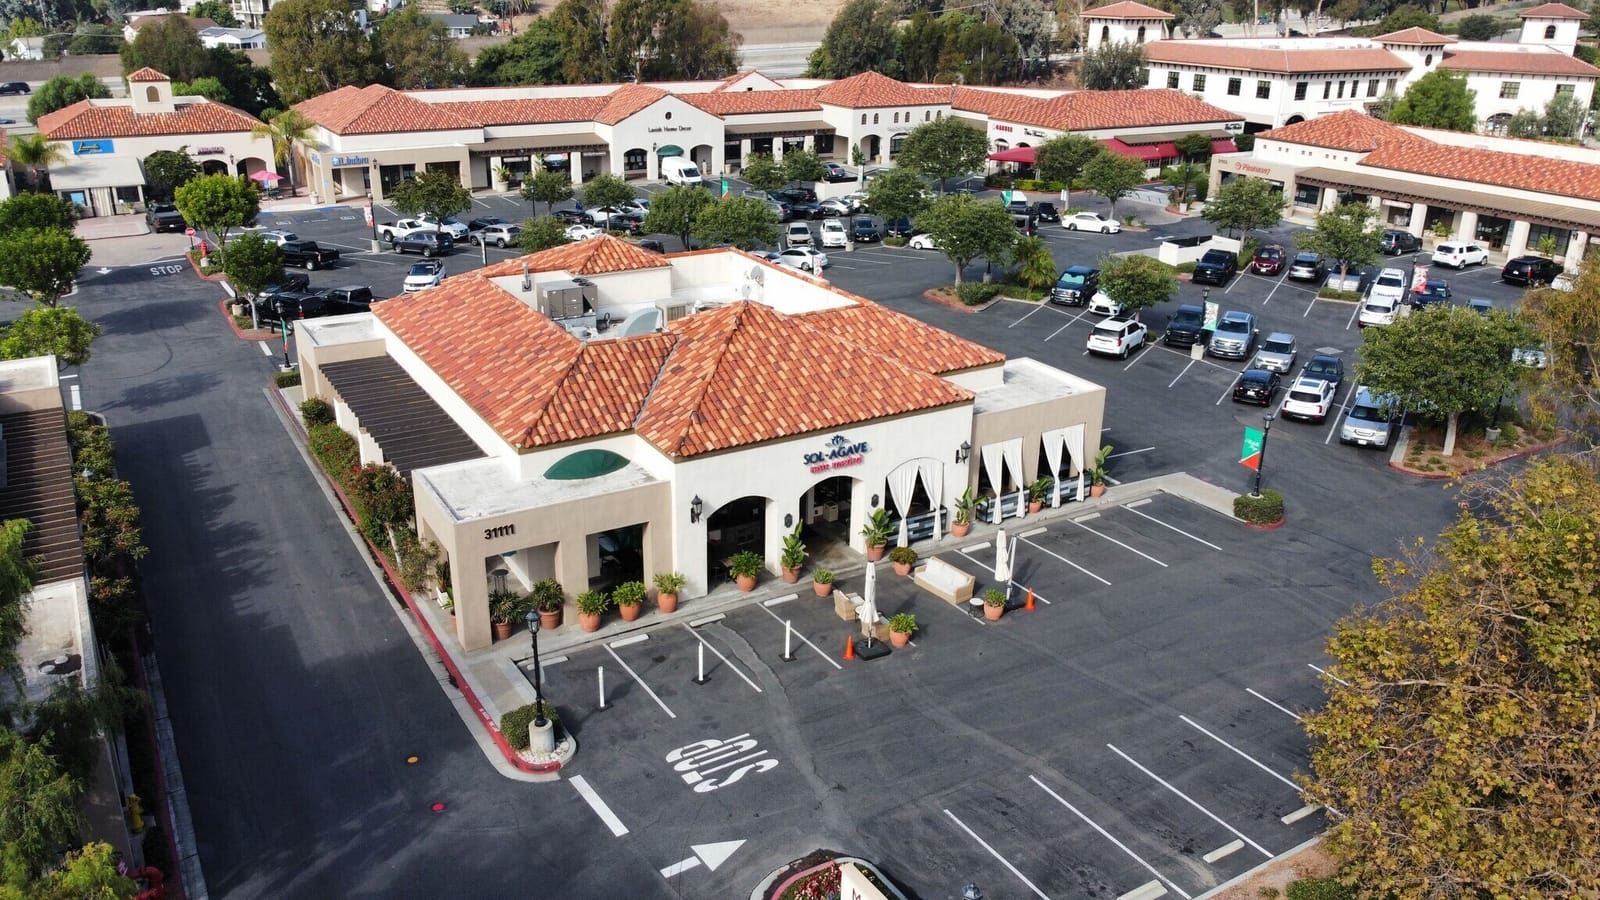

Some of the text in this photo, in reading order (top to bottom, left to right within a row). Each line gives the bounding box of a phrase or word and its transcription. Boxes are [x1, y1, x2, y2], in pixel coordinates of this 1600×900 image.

[150, 264, 183, 276] STOP
[484, 523, 515, 540] 31111
[665, 733, 779, 793] STOP
